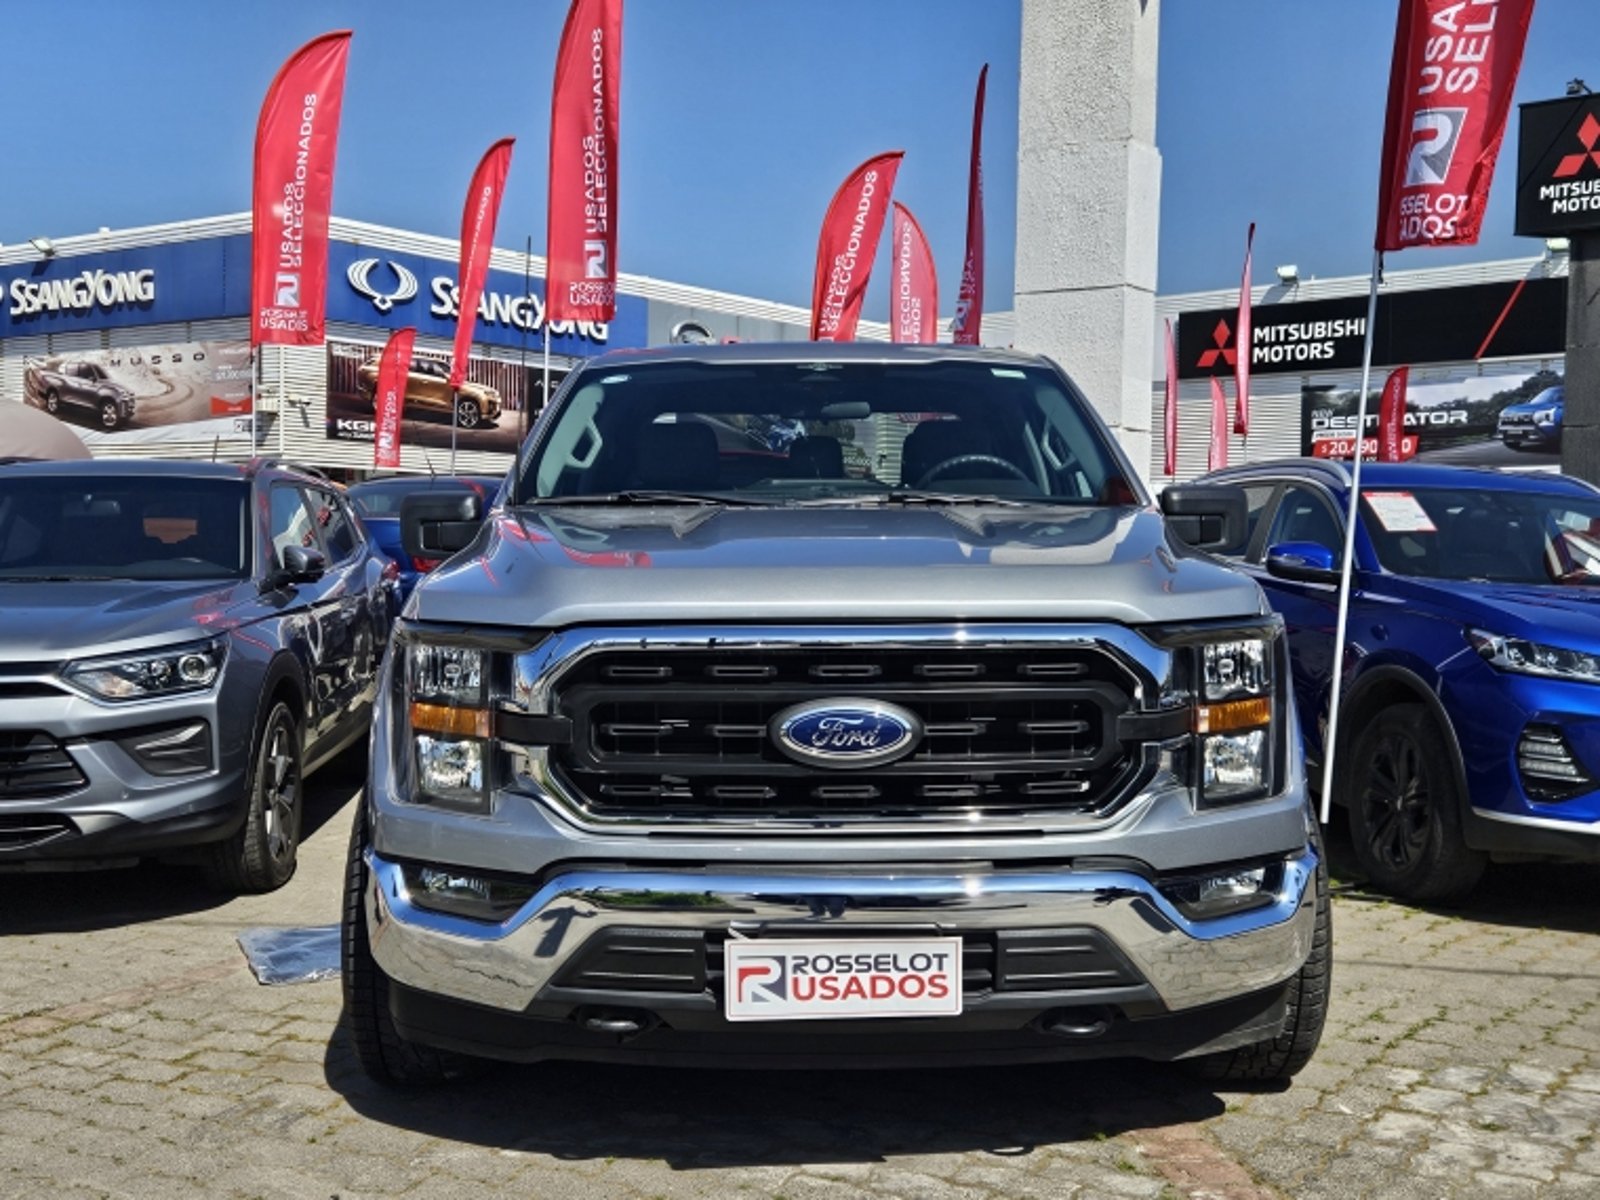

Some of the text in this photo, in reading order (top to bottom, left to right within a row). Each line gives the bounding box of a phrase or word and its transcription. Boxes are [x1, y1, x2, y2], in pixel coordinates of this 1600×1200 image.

[591, 27, 608, 233] SELECCIONADOS
[292, 93, 317, 267] SELECCIONADOS
[582, 135, 598, 233] USADOS
[280, 182, 295, 268] USADOS
[827, 170, 878, 332] SELECCIONADOS
[1254, 318, 1366, 343] MITSUBISHI
[1253, 340, 1335, 363] MOTORS
[1311, 409, 1469, 430] DESTIATOR
[1329, 437, 1412, 456] 20.900
[812, 717, 880, 747] Ford
[792, 953, 949, 973] ROSSELOT
[792, 974, 949, 1001] USADOS
